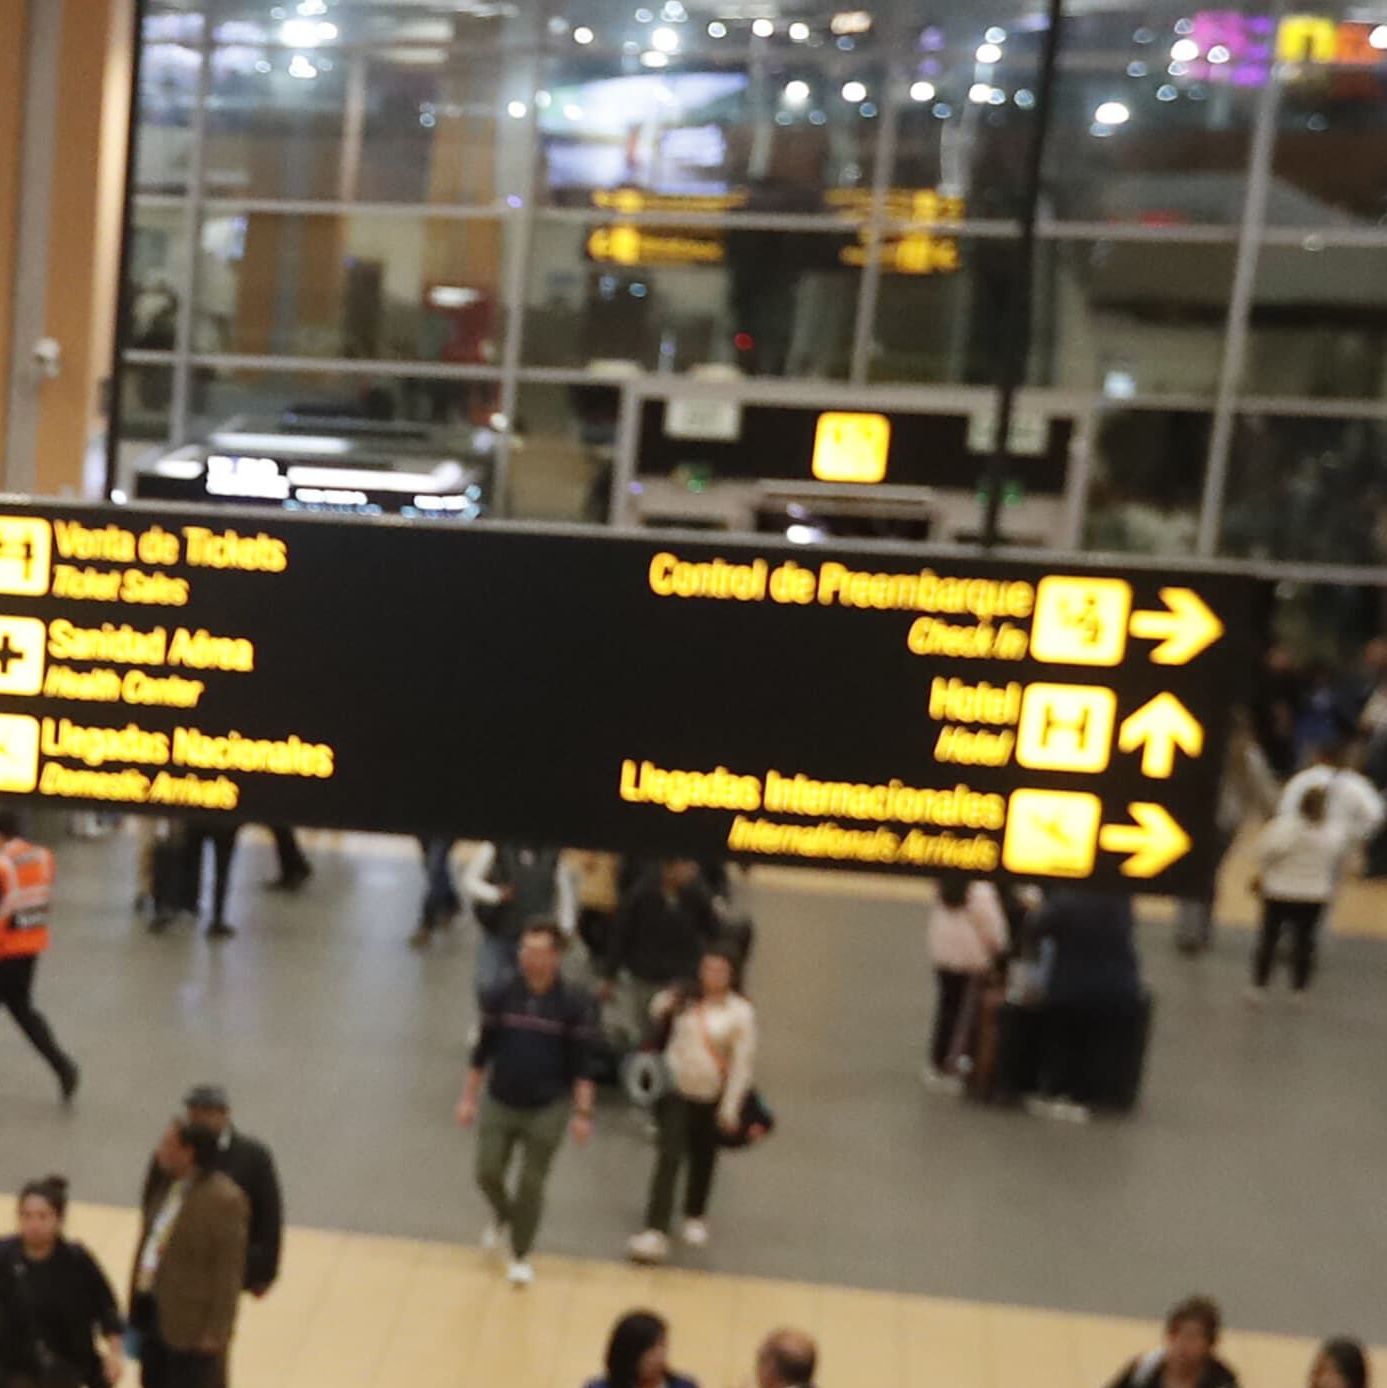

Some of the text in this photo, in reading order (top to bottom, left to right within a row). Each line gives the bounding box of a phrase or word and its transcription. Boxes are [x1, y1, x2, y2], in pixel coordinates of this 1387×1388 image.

[54, 518, 288, 573] Venta de Tickets
[52, 563, 190, 607] Ticket Sales
[649, 551, 1036, 622] Control de Preembarque
[47, 617, 167, 666] Sanidad
[907, 615, 997, 659] Check
[42, 663, 205, 708] Health Center
[929, 675, 1023, 726] Hotel
[41, 716, 335, 779] Llegadas Nacionales
[933, 724, 1015, 768] Hotel
[148, 770, 240, 811] Arrivals
[619, 758, 1007, 831] Llegadas Internacionales
